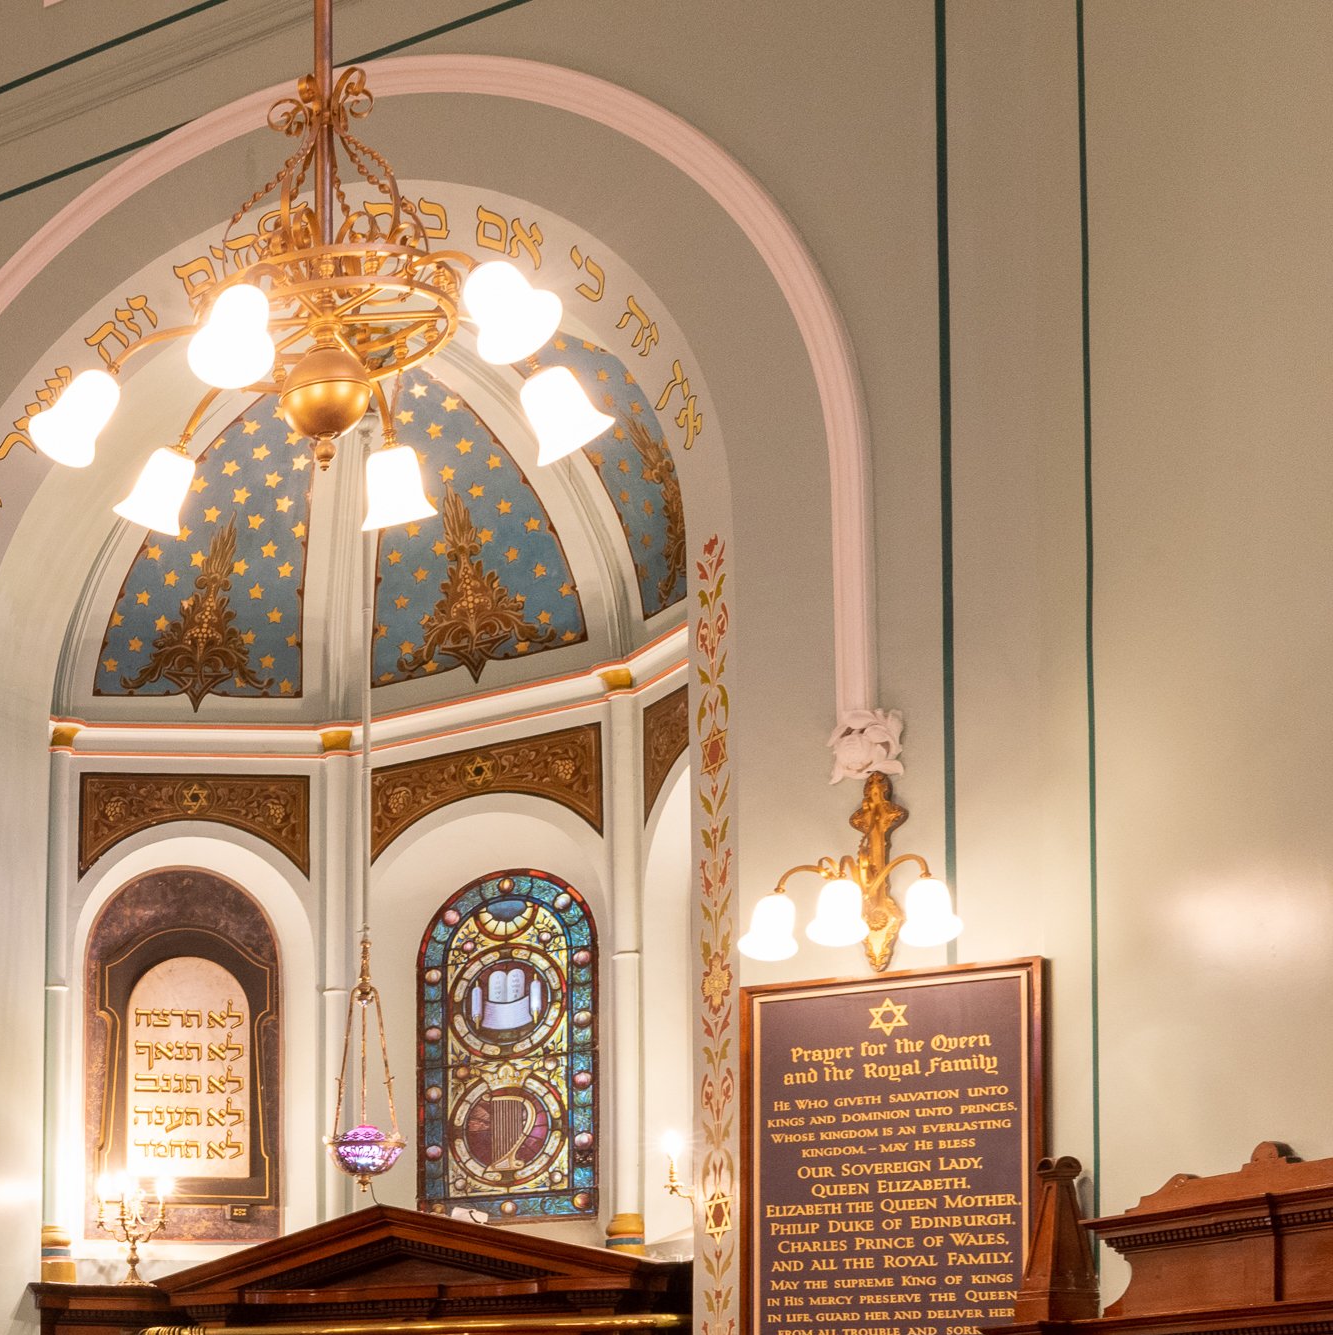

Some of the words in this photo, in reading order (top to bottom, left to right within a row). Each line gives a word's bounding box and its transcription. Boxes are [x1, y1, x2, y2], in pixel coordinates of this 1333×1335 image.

[476, 205, 544, 270] אם
[570, 245, 605, 302] כי
[615, 295, 659, 356] זה
[135, 1008, 202, 1028] תרצח
[206, 999, 245, 1029] לא
[134, 1040, 202, 1070] תנאף
[206, 1032, 245, 1062] לא
[790, 1046, 854, 1066] Prayer
[860, 1041, 888, 1057] for
[894, 1038, 925, 1054] the
[206, 1065, 245, 1095] לא
[783, 1067, 818, 1086] and
[823, 1066, 854, 1082] the
[862, 1059, 921, 1083] Royal
[924, 1054, 999, 1077] Family
[134, 1073, 202, 1094] תגנב
[774, 1100, 791, 1112] HE
[794, 1099, 829, 1110] WHO
[833, 1095, 881, 1107] GIVETH
[889, 1089, 960, 1103] SALVATION
[967, 1085, 1009, 1097] UNTO
[134, 1105, 202, 1133] תענה
[206, 1097, 245, 1127] לא
[767, 1117, 805, 1128] KINGS
[809, 1115, 836, 1125] AND
[841, 1109, 910, 1123] DOMINION
[915, 1106, 953, 1117] UNTO
[770, 1132, 816, 1144] WHOSE
[819, 1128, 879, 1140] KINGDOM
[882, 1127, 893, 1136] IS
[897, 1125, 916, 1136] AN
[922, 1119, 1012, 1134] EVERLASTING
[206, 1130, 245, 1160] לא
[879, 1142, 909, 1153] MAY
[914, 1140, 934, 1151] HE
[938, 1138, 976, 1149] BLESS
[797, 1166, 836, 1179] OUR
[841, 1160, 932, 1177] SOVEREIGN
[811, 1182, 869, 1199] QUEEN
[766, 1203, 842, 1218] ELIZABETH
[845, 1201, 875, 1213] THE
[880, 1197, 937, 1214] QUEEN
[770, 1222, 820, 1236] PHILIP
[828, 1220, 875, 1233] DUKE
[881, 1218, 902, 1231] OF
[777, 1240, 848, 1254] CHARLES
[854, 1237, 915, 1251] PRINCE
[923, 1235, 944, 1248] OF
[771, 1260, 804, 1272] AND
[810, 1259, 838, 1271] ALL
[842, 1257, 875, 1270] THE
[883, 1255, 938, 1268] ROYAL
[770, 1280, 800, 1291] MAY
[803, 1280, 828, 1290] THE
[834, 1277, 895, 1289] SUPREME
[901, 1275, 937, 1286] KING
[944, 1275, 963, 1285] OF
[971, 1273, 1013, 1284] KINGS
[767, 1298, 780, 1307] IN
[784, 1296, 804, 1306] HIS
[808, 1295, 853, 1306] MERCY
[859, 1293, 922, 1304] PRESERVE
[929, 1292, 957, 1302] THE
[964, 1290, 1019, 1303] QUEEN
[767, 1314, 782, 1323] IN
[815, 1312, 861, 1322] GUARD
[864, 1311, 891, 1321] HER
[893, 1310, 922, 1320] AND
[926, 1309, 985, 1319] DELIVER
[988, 1308, 1015, 1318] HER
